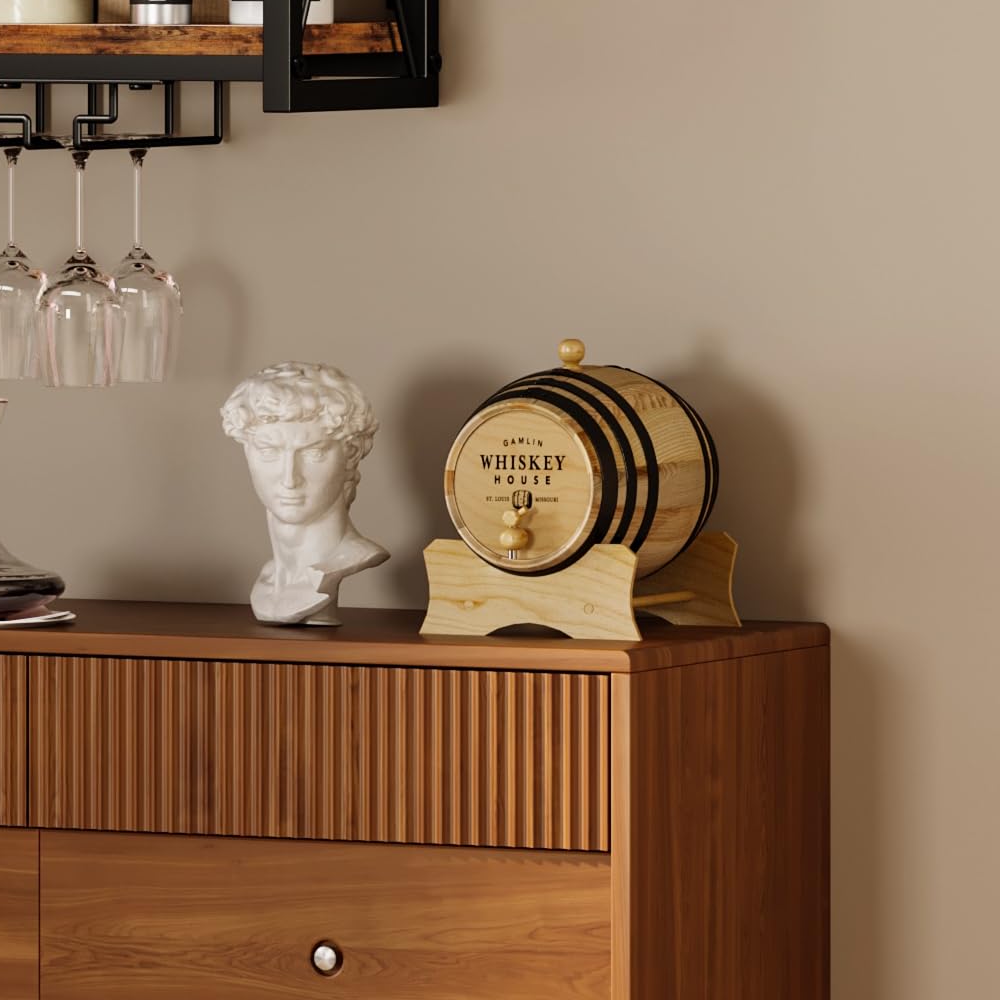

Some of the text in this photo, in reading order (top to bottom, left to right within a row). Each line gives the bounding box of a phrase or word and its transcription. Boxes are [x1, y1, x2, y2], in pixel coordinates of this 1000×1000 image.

[503, 436, 544, 447] GAMLIN
[480, 454, 566, 471] WHISKEY
[494, 475, 551, 485] HOUSE
